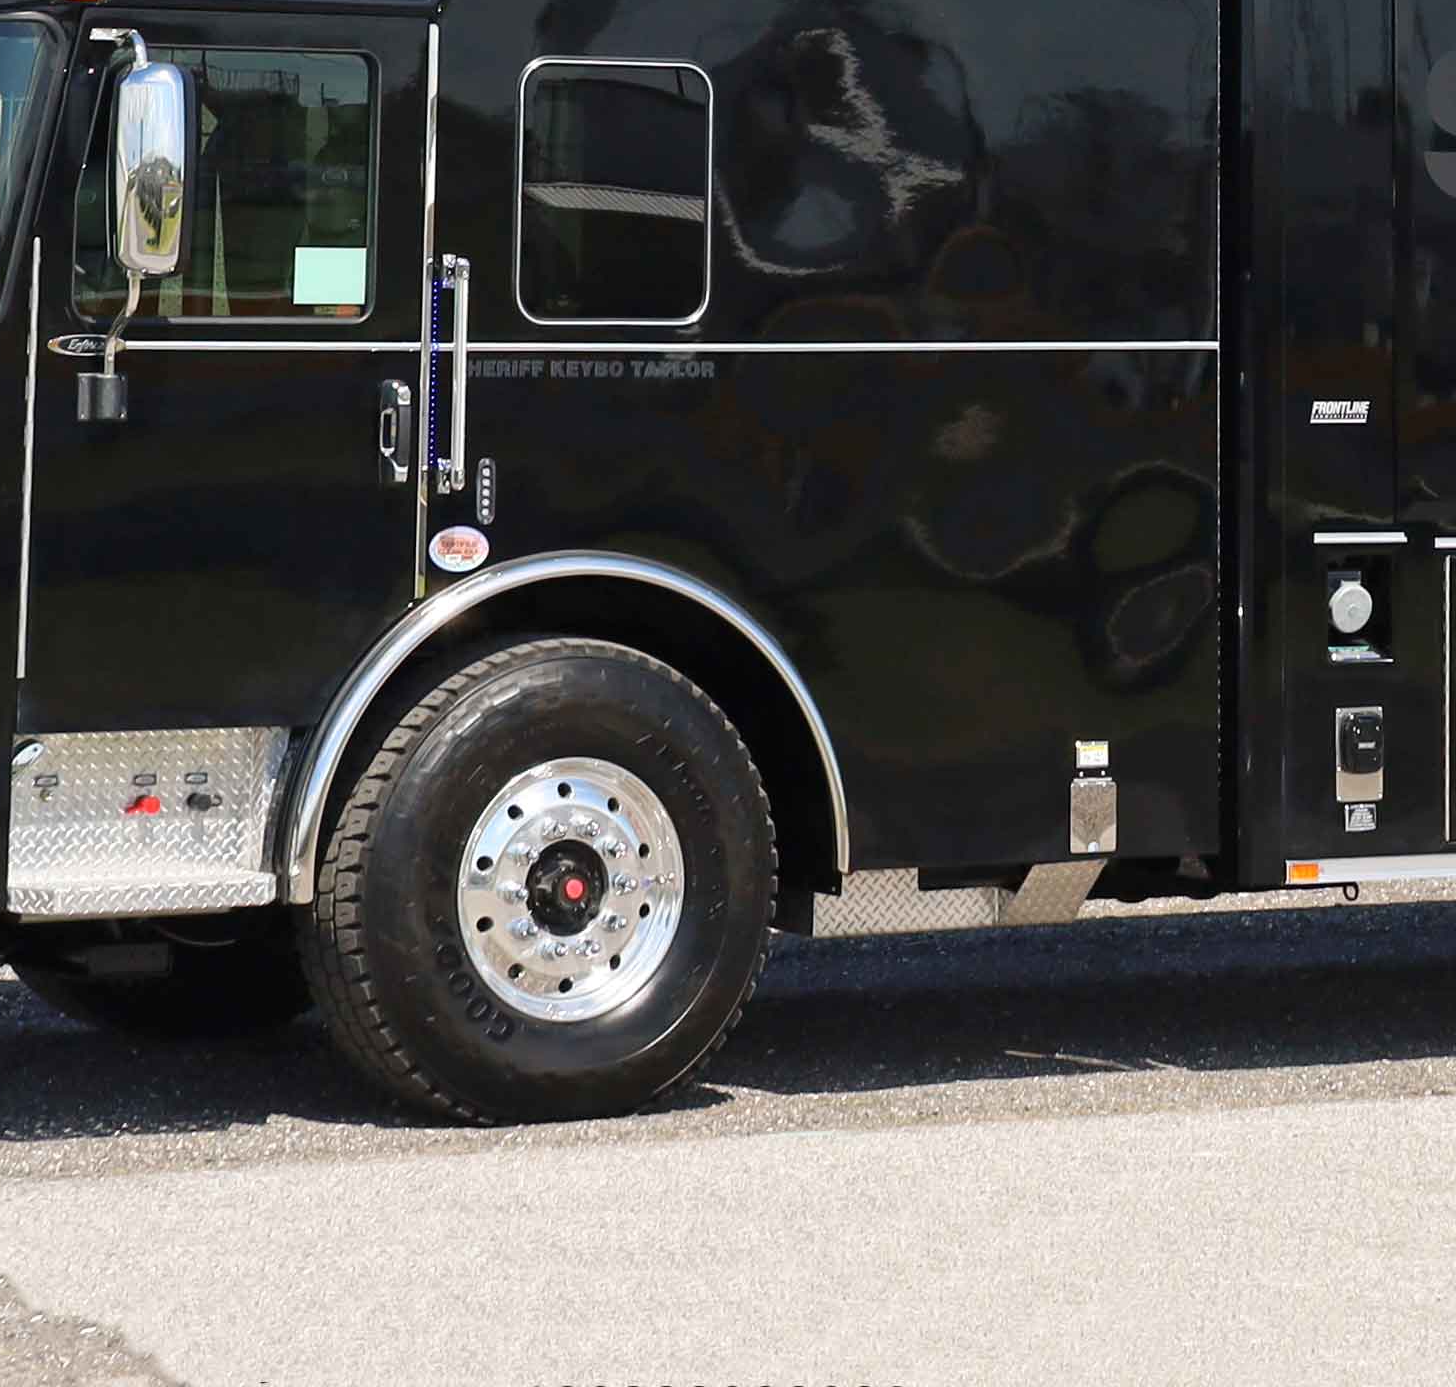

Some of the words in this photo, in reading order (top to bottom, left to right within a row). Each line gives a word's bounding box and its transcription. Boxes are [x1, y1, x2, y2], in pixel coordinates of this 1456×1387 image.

[467, 359, 544, 378] HERIFF
[550, 359, 625, 378] KEYBO
[1312, 401, 1370, 414] FRONTLINE
